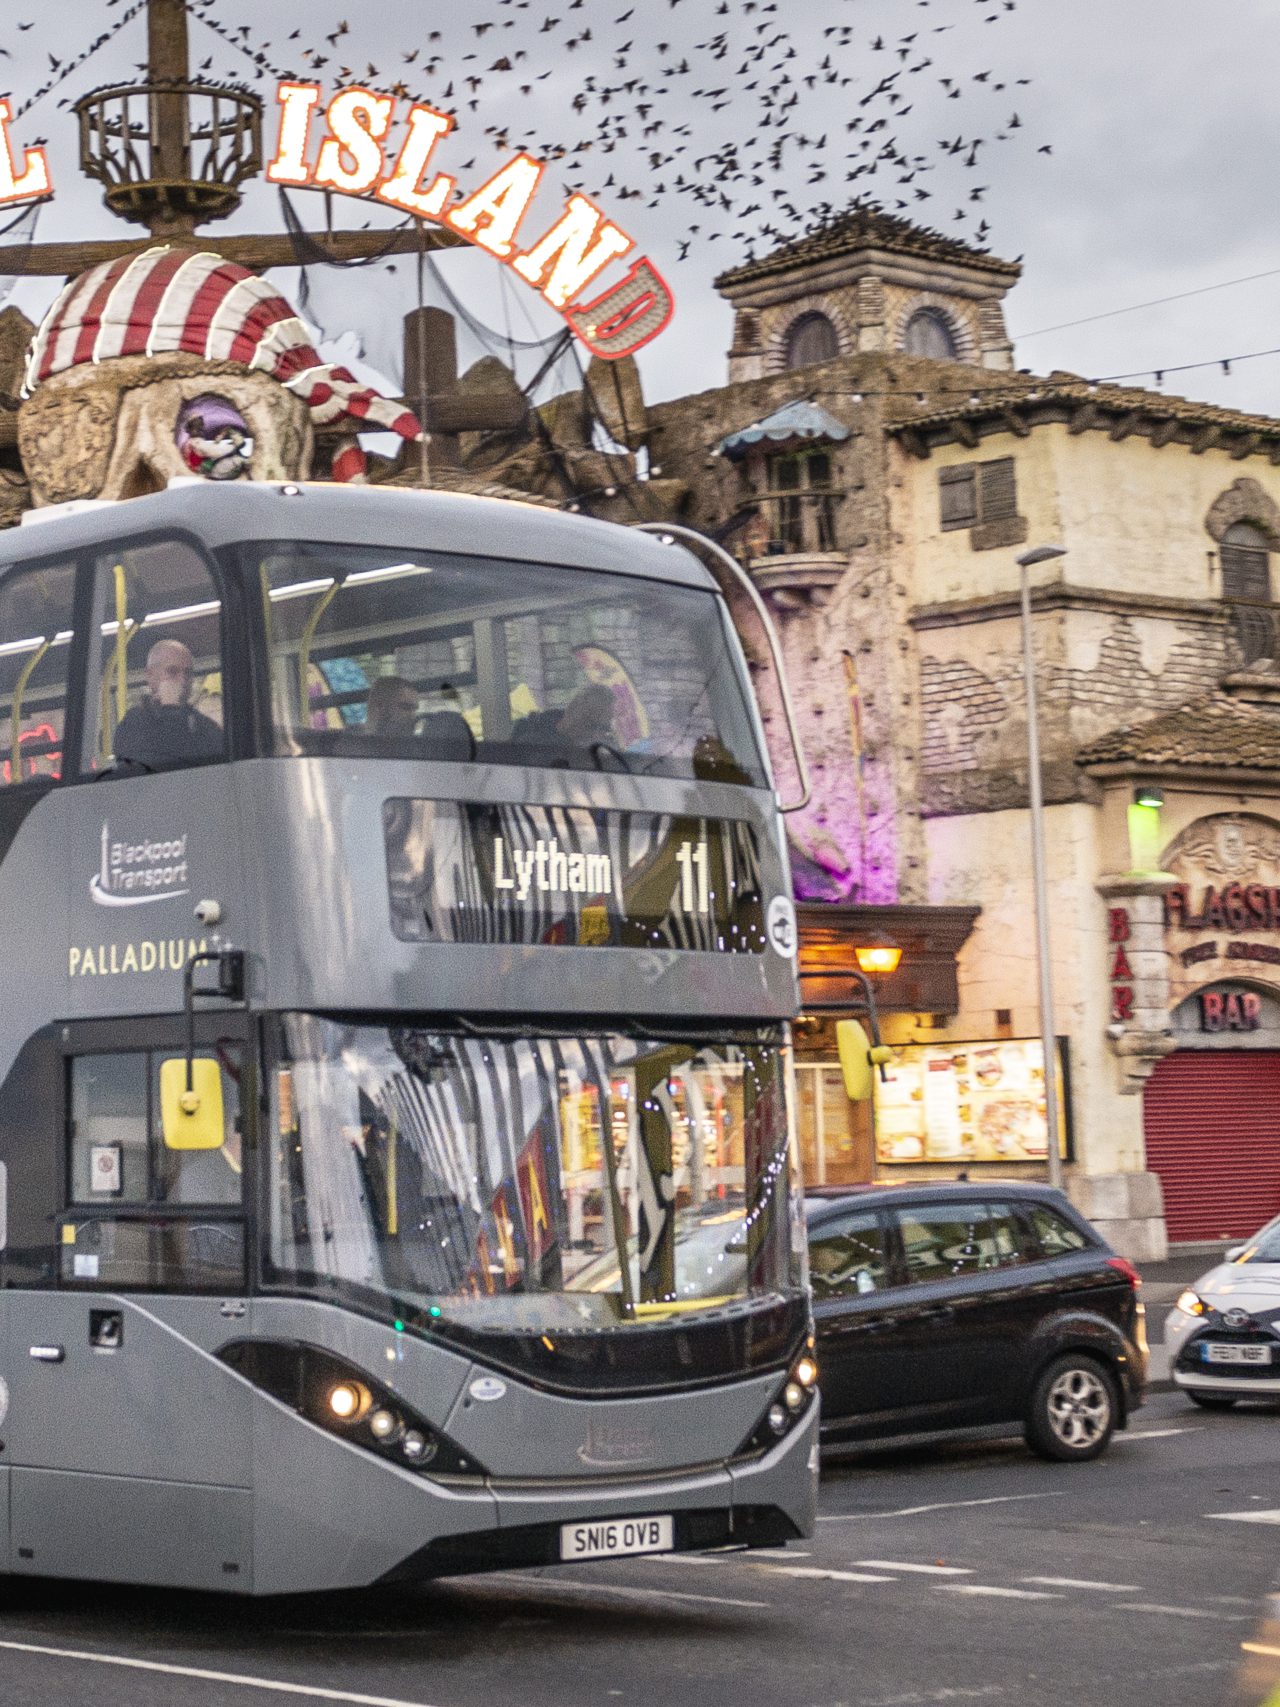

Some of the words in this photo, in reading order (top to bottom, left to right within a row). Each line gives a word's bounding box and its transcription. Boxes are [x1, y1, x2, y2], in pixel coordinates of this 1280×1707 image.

[266, 81, 676, 359] ISLAND
[111, 833, 188, 865] Blackpool
[111, 861, 188, 891] Transport
[494, 837, 611, 900] Lytham
[675, 841, 709, 912] 11
[69, 938, 209, 976] PALLADIUM
[1108, 908, 1134, 1020] BAR
[1200, 993, 1261, 1031] BAR
[575, 1525, 617, 1552] SN16
[624, 1522, 660, 1548] OVB
